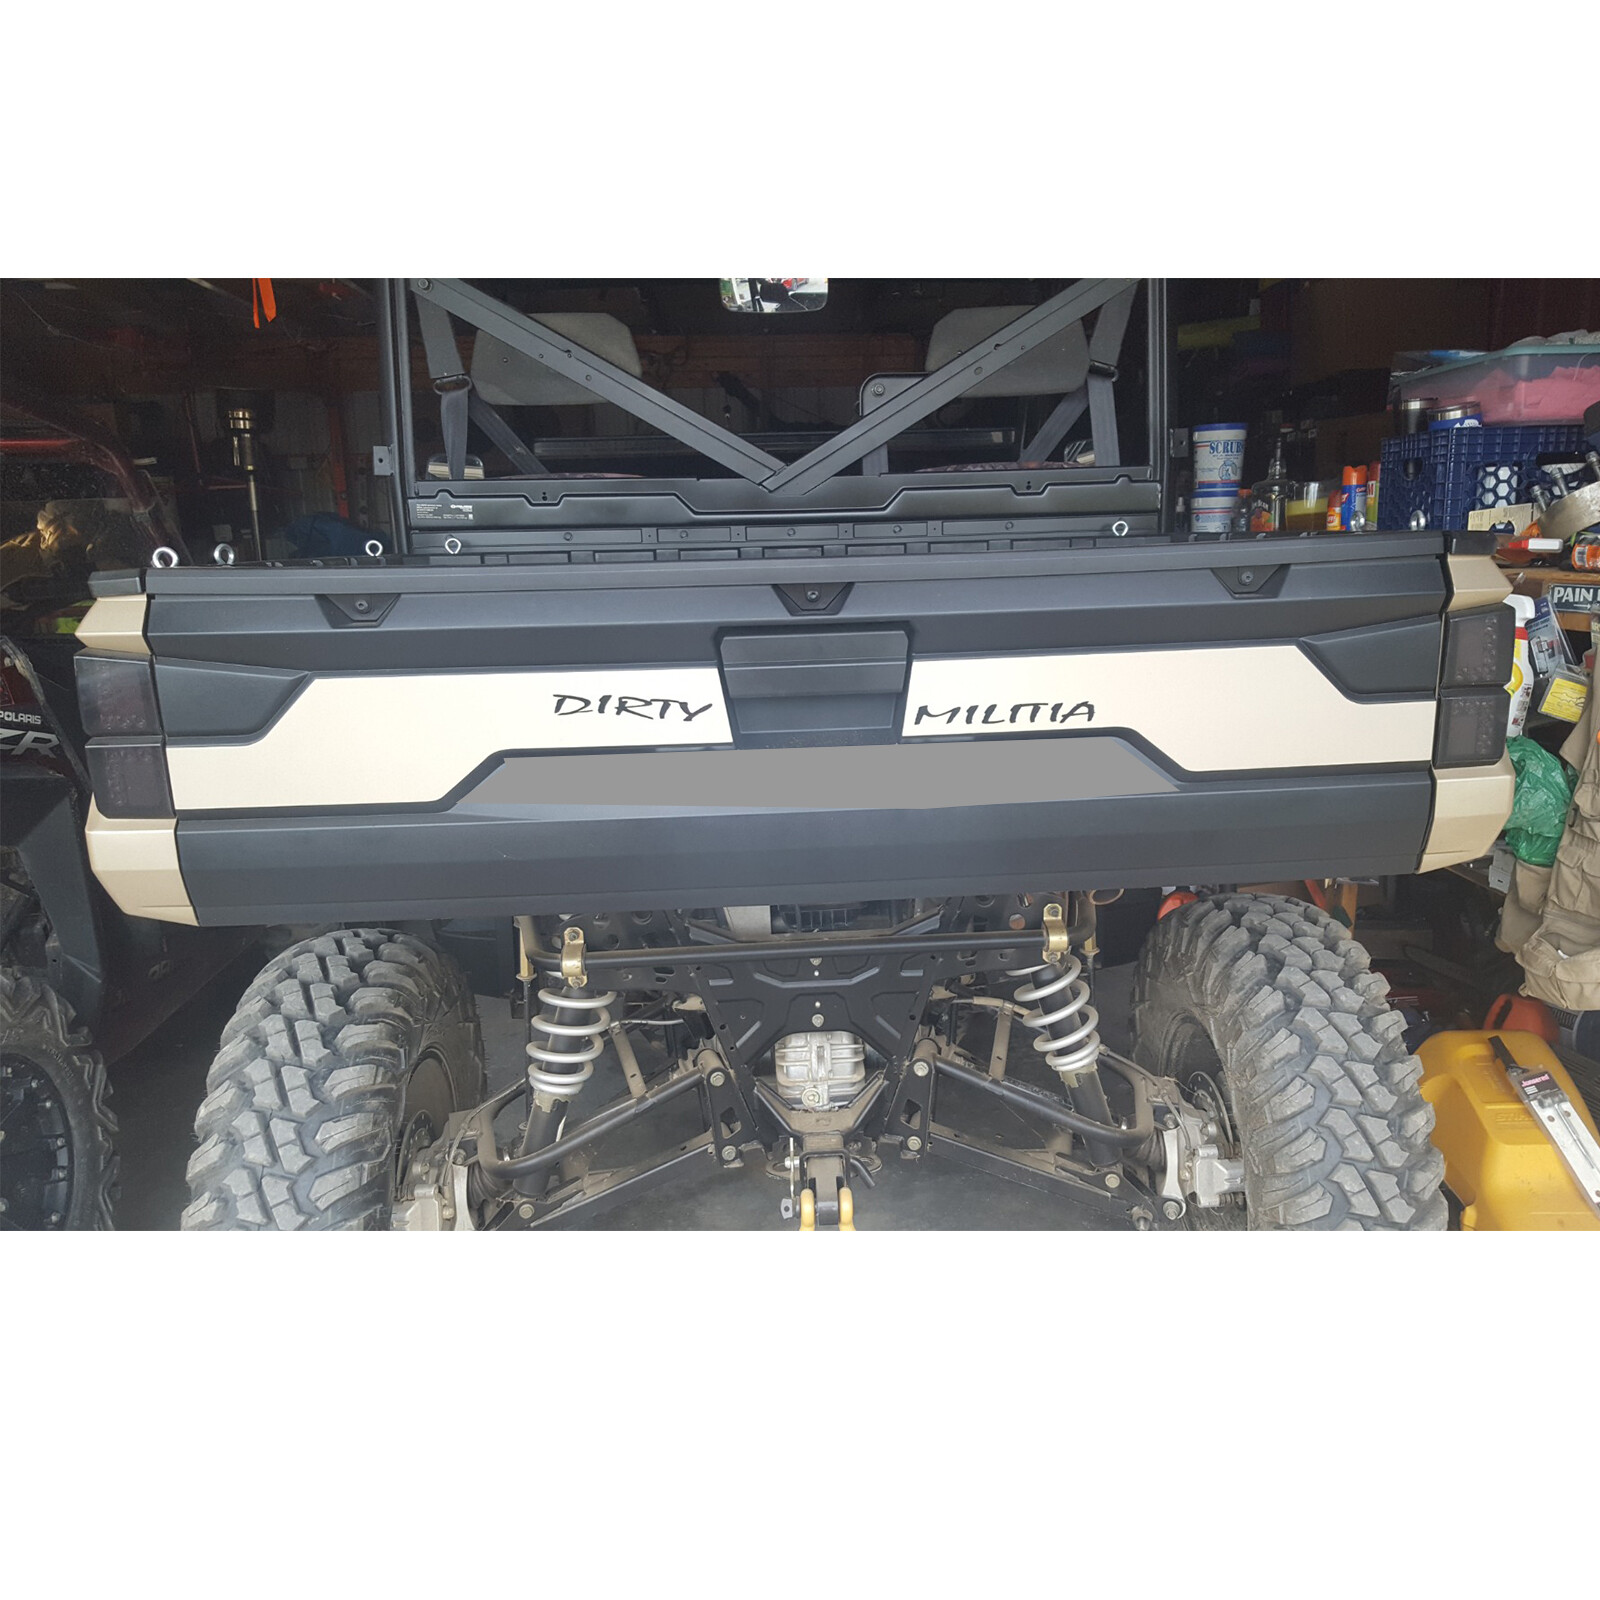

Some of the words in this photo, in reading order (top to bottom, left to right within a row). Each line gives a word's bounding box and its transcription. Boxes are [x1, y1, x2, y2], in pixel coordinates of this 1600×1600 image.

[1209, 441, 1244, 454] SCRUB
[1553, 586, 1594, 603] PAIN
[0, 710, 42, 725] POLARIS
[553, 694, 713, 722] DIRTY
[914, 701, 1096, 726] MILITIA
